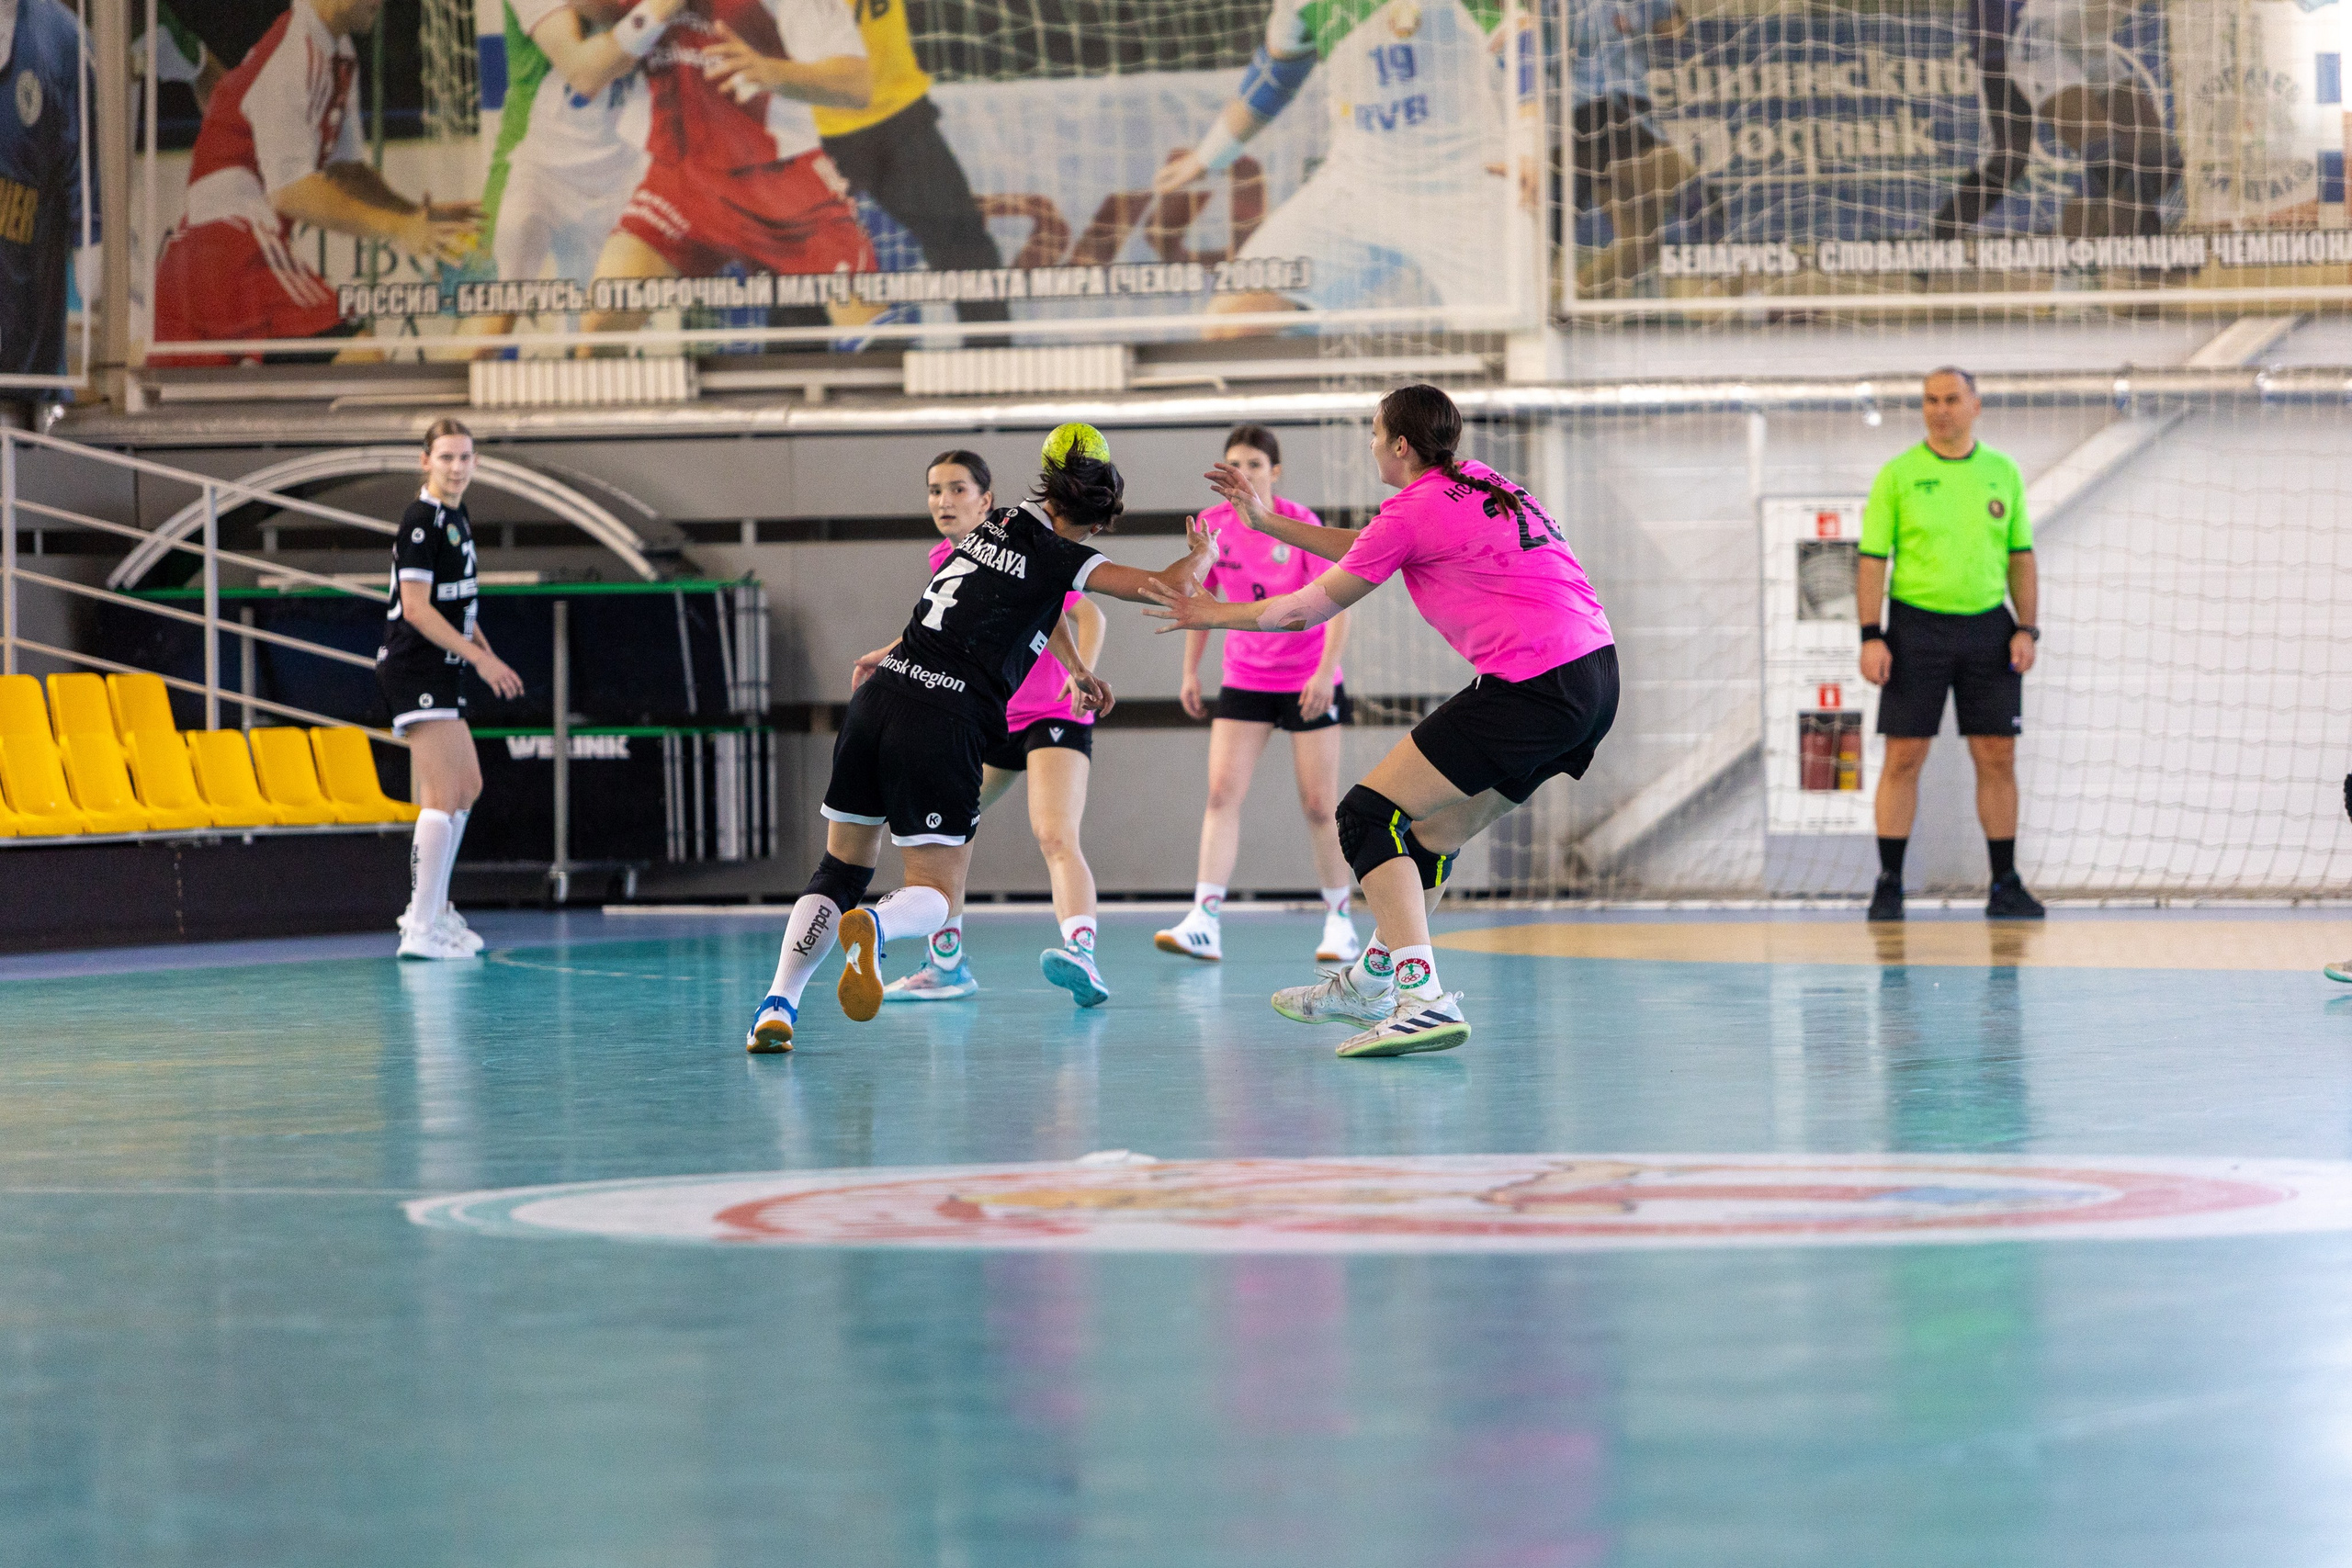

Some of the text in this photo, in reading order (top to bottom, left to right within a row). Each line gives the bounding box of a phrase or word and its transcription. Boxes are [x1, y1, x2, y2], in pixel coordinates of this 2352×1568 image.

[1368, 44, 1416, 86] 19
[1660, 243, 1799, 275] БЕЛАРУСЬ
[1978, 235, 2205, 269] КВАЛИФИКАЦИЯ
[339, 284, 439, 315] РОССИЯ
[595, 274, 771, 310] ОТБОРОЧНЫЙ
[777, 276, 851, 306] МАТЧ
[854, 268, 1026, 303] ЧЕМПИОНАТА
[1029, 265, 1103, 297] МИРА
[921, 556, 978, 631] 4
[910, 663, 966, 693] Region
[505, 735, 631, 760] WEINK
[793, 905, 832, 956] Kempa
